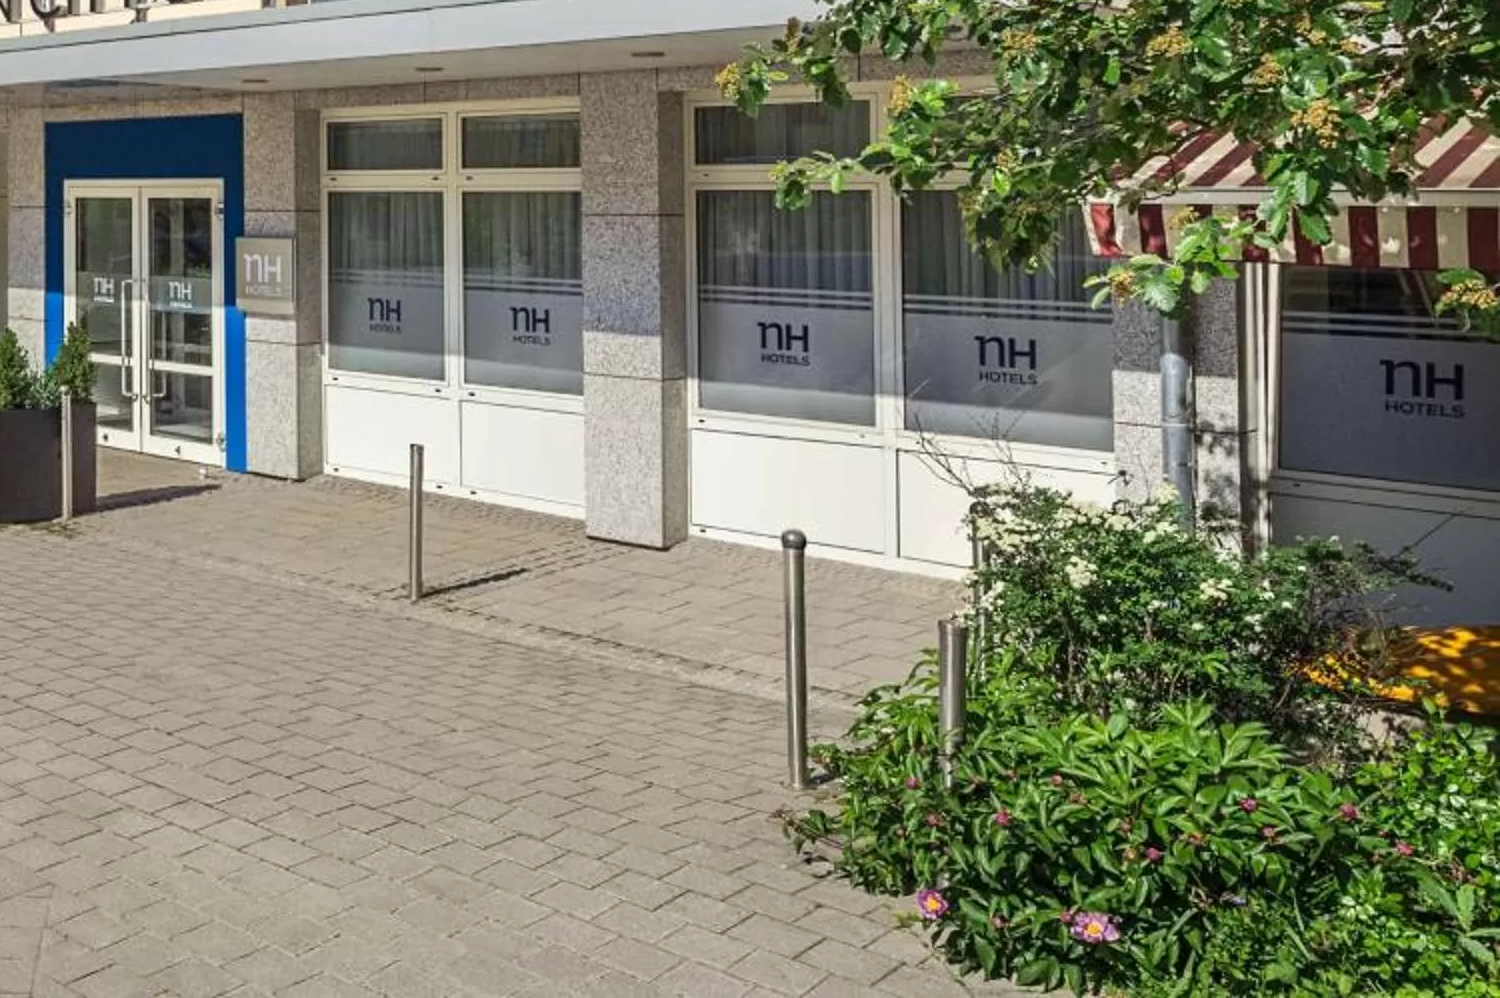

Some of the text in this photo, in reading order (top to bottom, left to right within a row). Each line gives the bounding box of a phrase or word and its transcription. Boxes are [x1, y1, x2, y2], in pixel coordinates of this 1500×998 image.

[761, 354, 810, 367] HOTELS
[979, 370, 1038, 385] HOTELS
[1385, 401, 1465, 419] HOTELS
